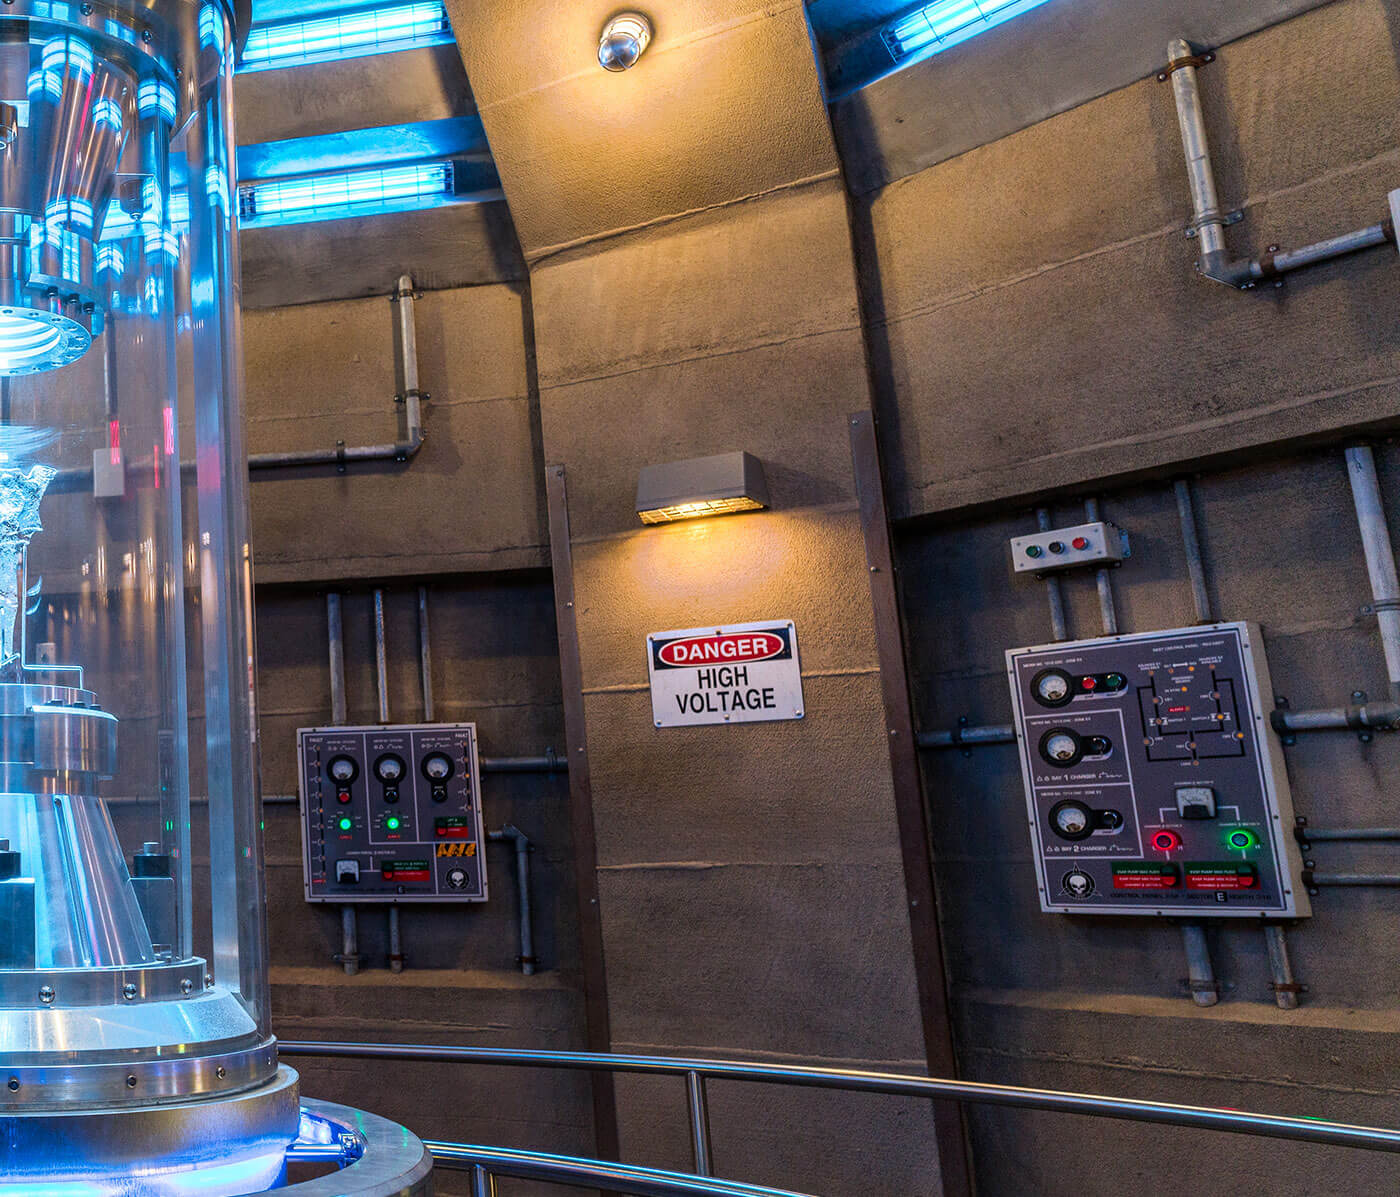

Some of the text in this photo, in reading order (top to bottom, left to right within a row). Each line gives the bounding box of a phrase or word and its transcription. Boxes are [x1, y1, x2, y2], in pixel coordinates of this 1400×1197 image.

[673, 638, 769, 662] DANGER
[697, 665, 749, 689] HIGH
[675, 688, 777, 715] VOLTAGE
